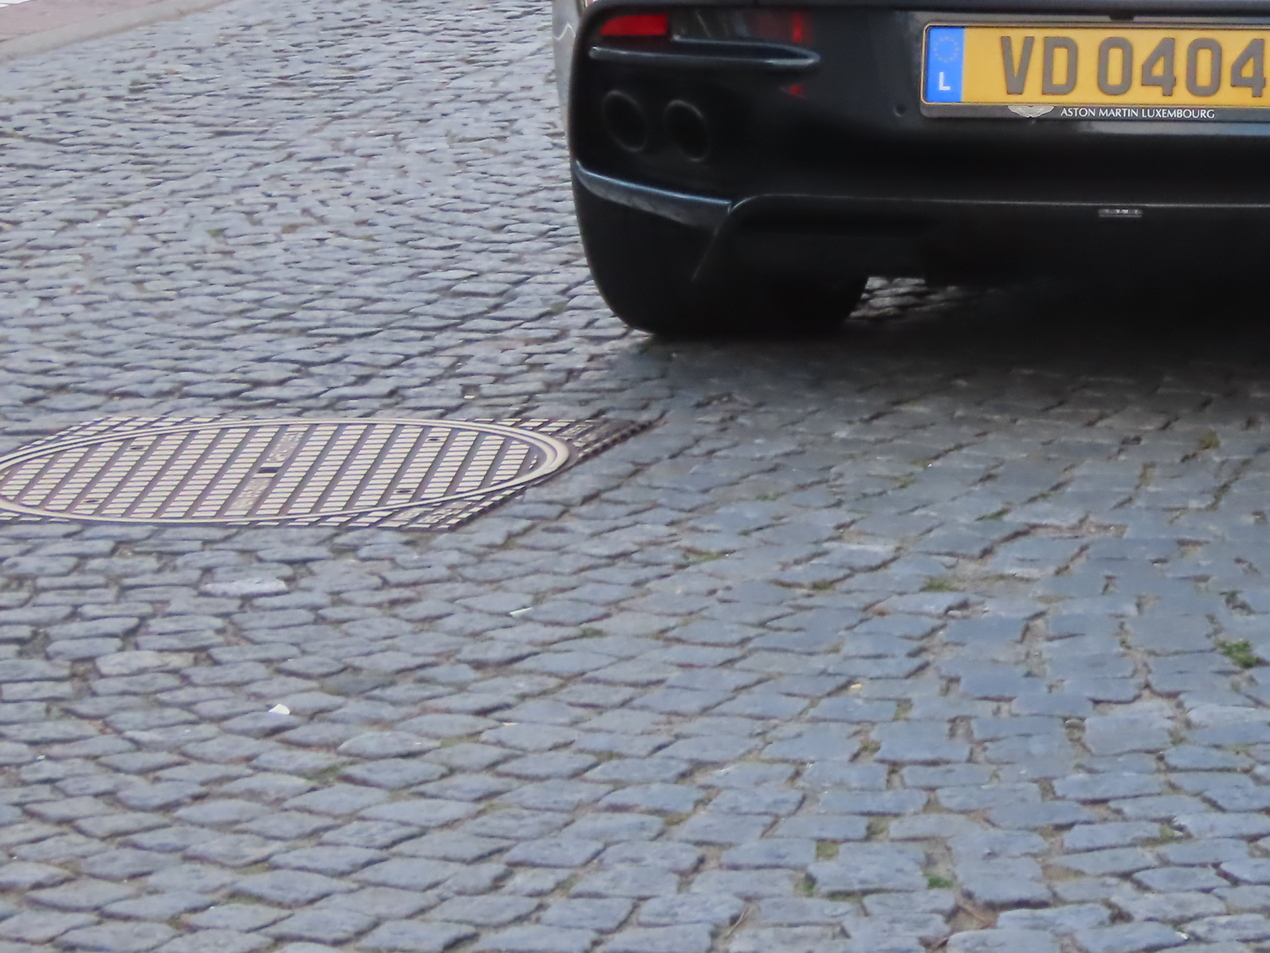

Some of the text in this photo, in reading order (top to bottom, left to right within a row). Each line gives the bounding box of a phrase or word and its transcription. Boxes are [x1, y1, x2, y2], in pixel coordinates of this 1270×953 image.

[1000, 35, 1267, 98] VD 0404
[938, 71, 951, 91] L
[1060, 107, 1215, 119] ASTON MARTIN LUXEMBOURG
